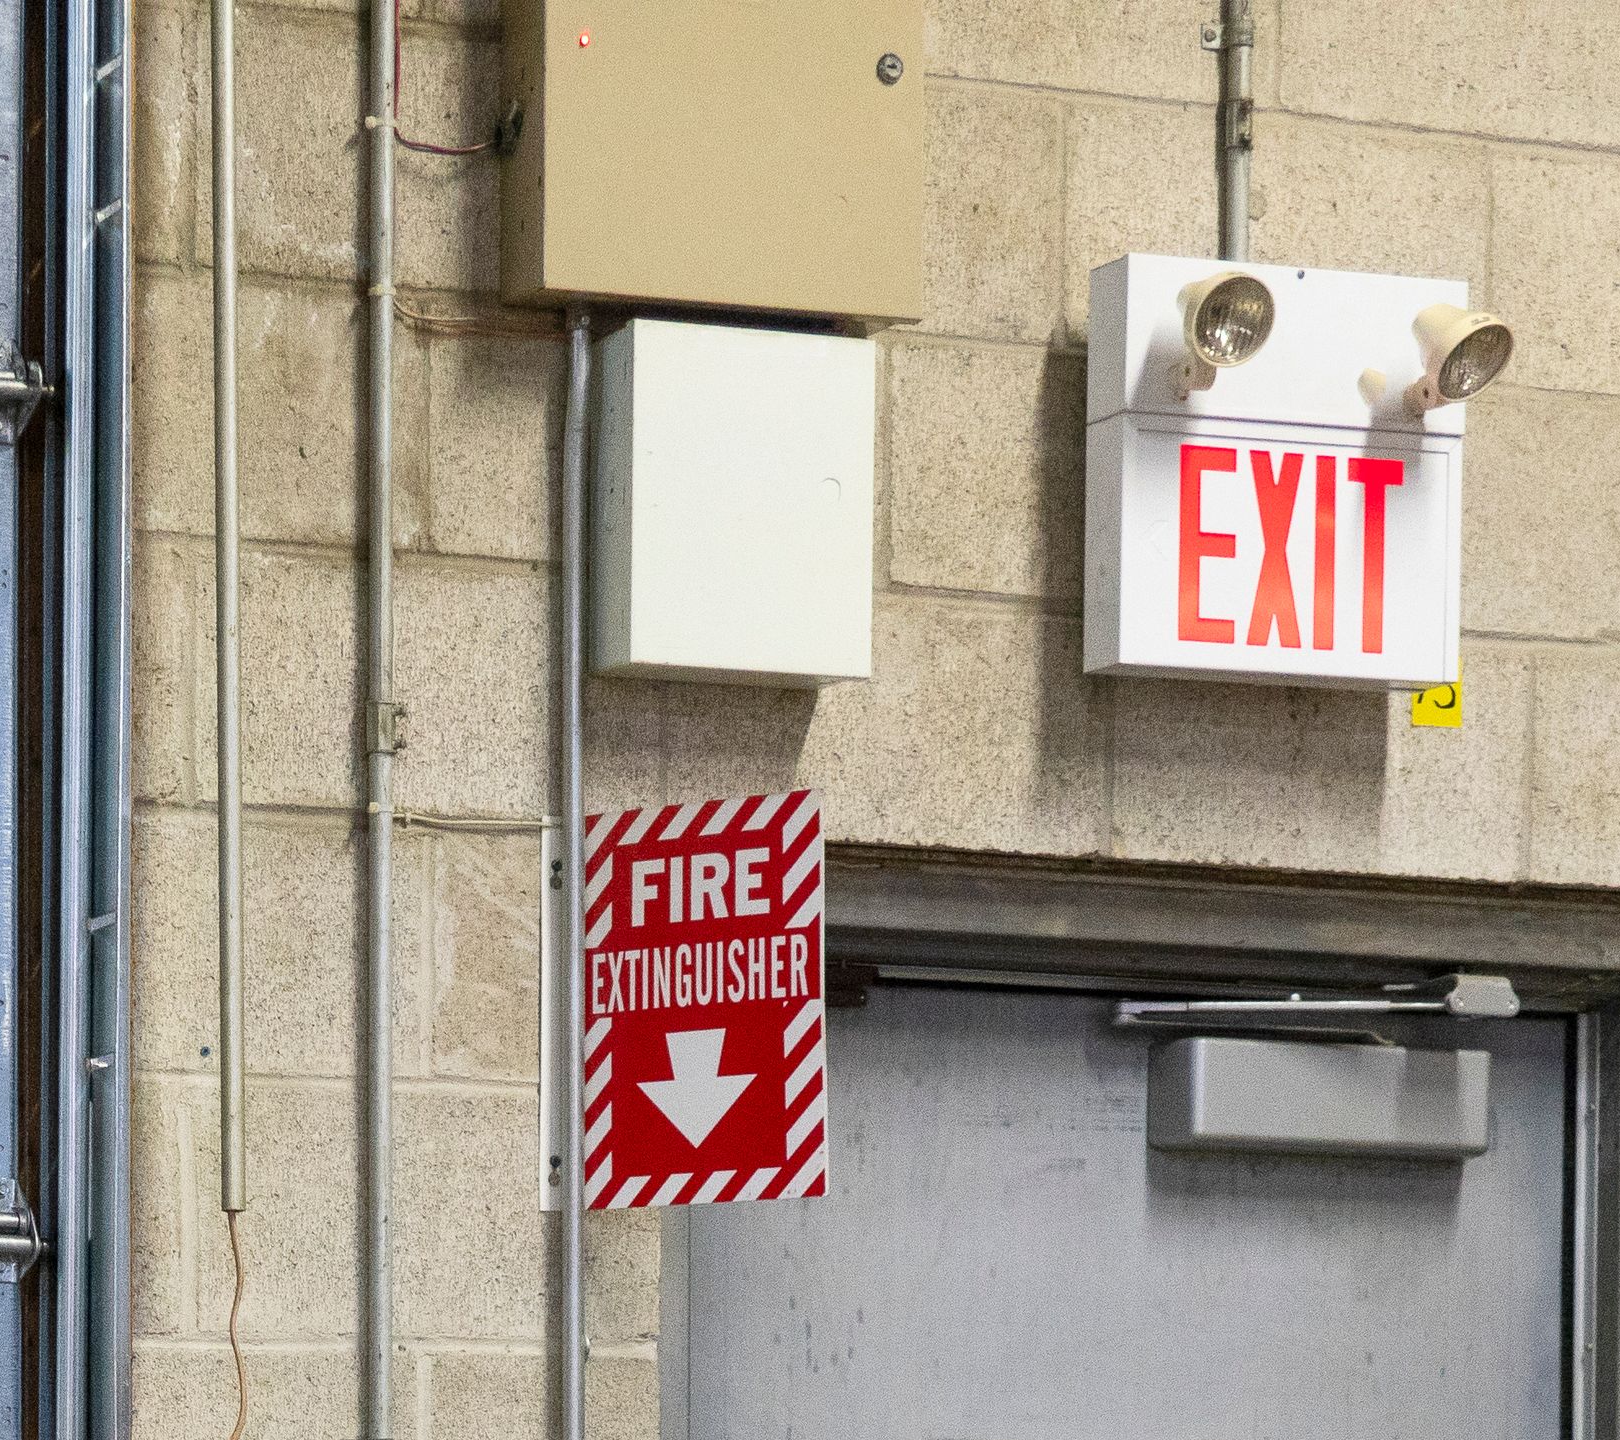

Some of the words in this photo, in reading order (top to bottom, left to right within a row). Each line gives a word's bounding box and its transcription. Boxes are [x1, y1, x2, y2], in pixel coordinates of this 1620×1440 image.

[1178, 444, 1404, 654] EXIT
[631, 847, 770, 927] FIRE
[592, 934, 809, 1014] EXTINGUISHER
